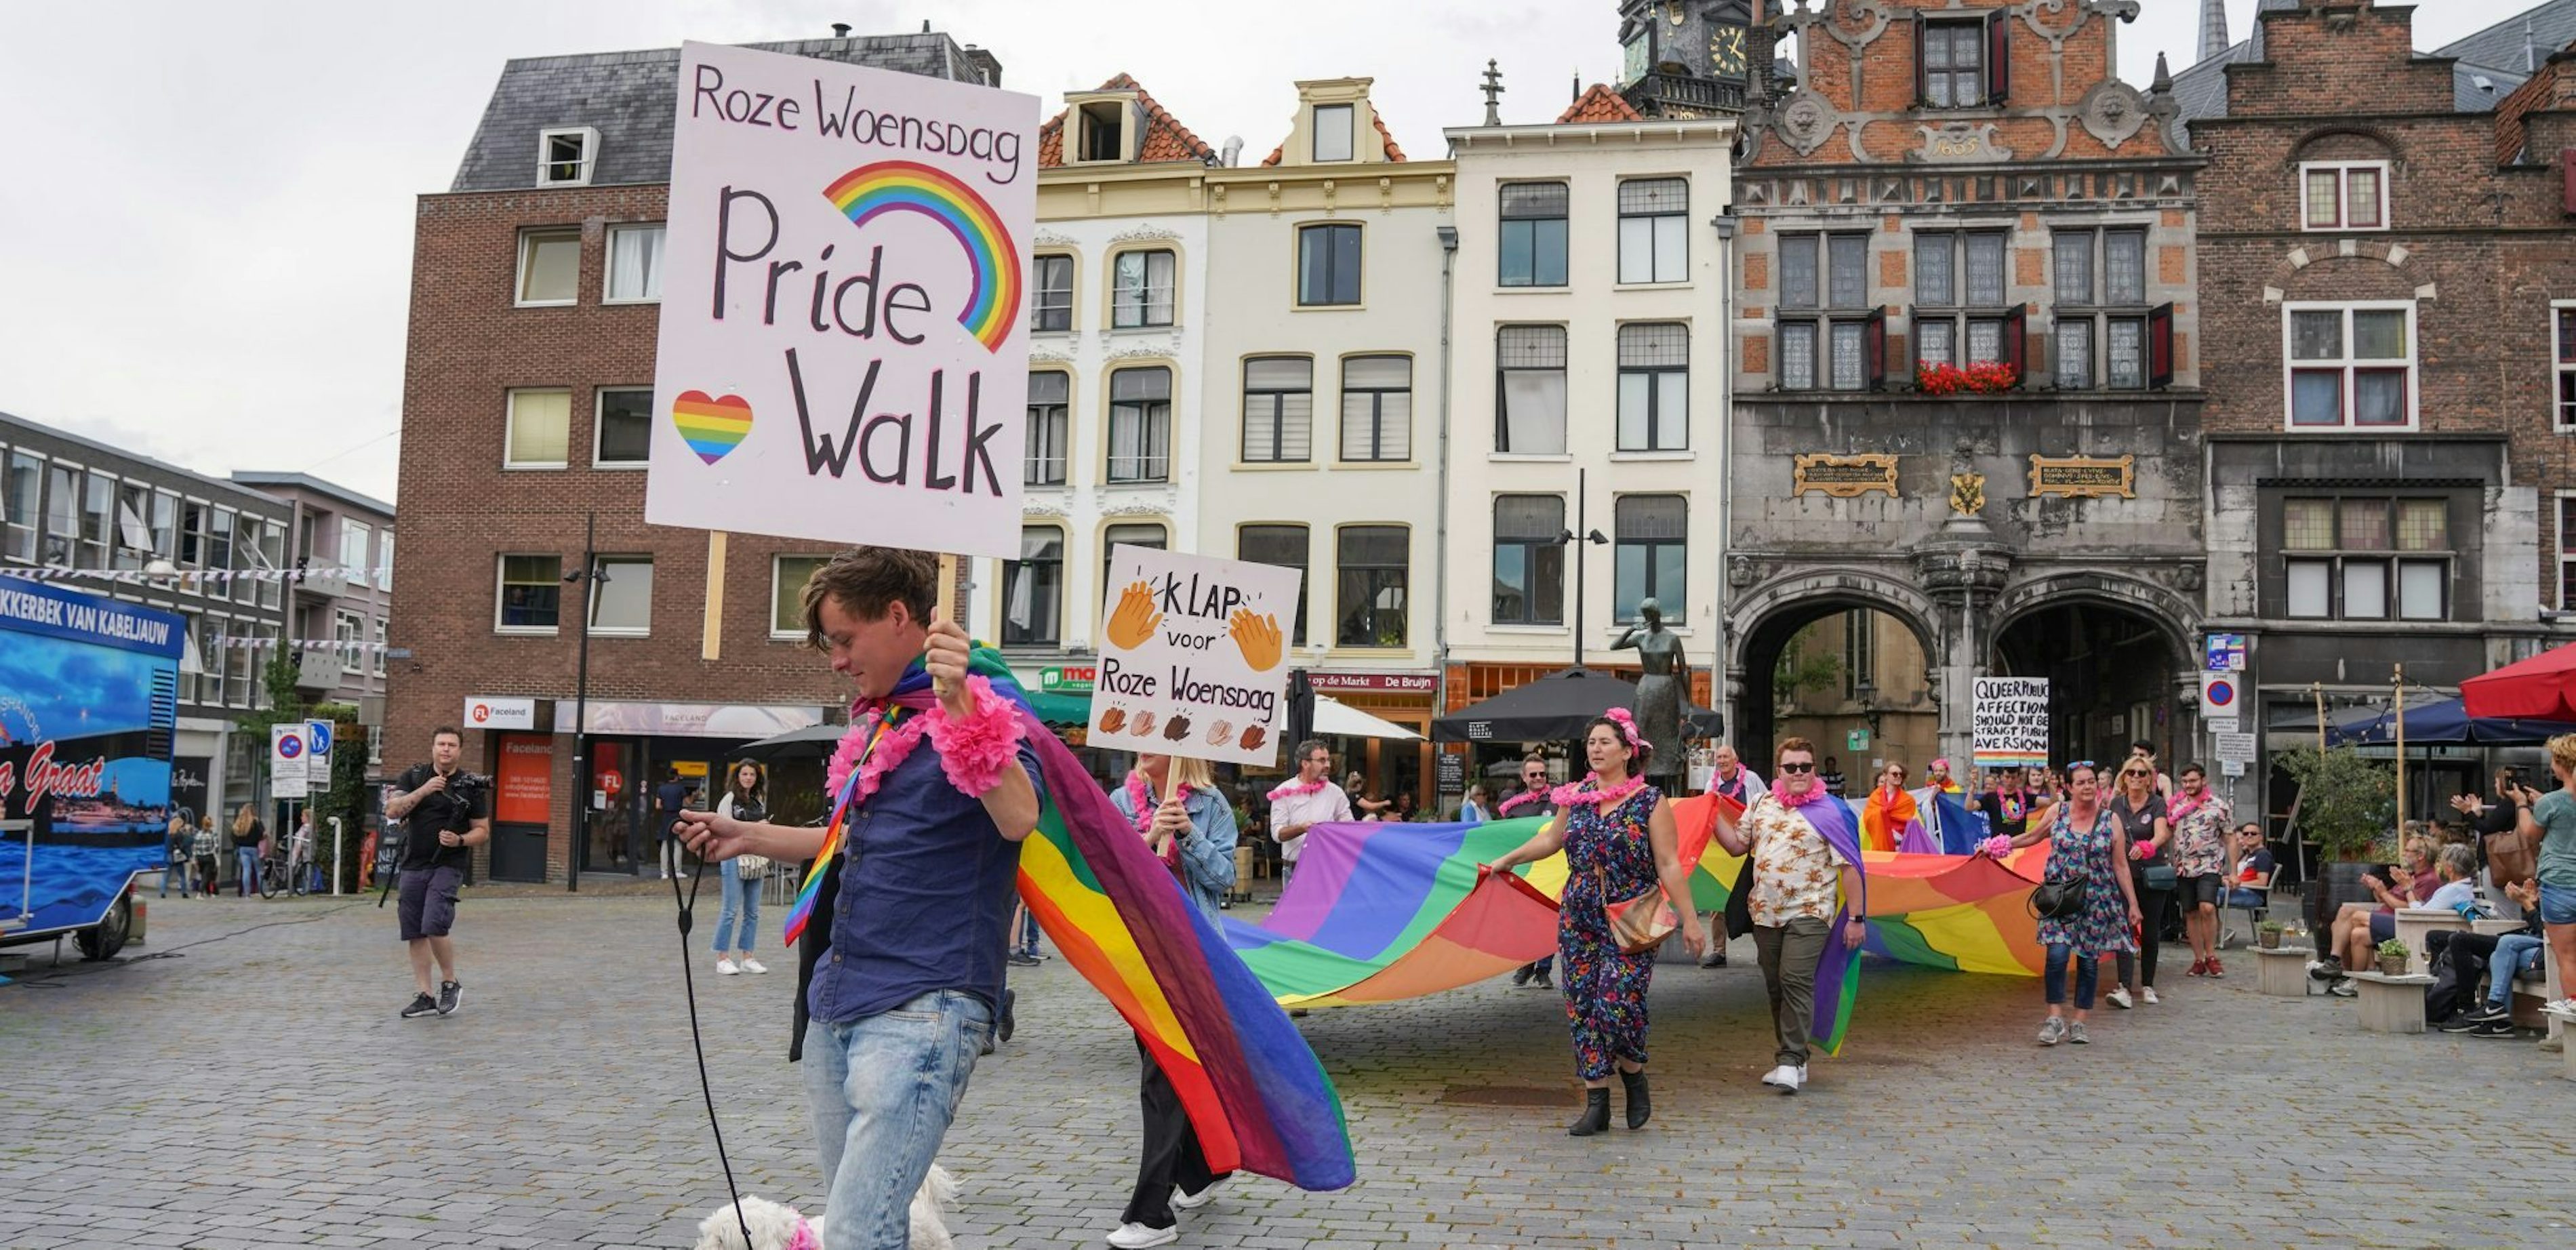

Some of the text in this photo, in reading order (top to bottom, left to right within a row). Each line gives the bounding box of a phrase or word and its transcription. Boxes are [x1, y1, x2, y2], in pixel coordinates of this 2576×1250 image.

[693, 64, 801, 130] Roze
[712, 186, 931, 345] Pride
[785, 348, 1003, 498] Walk
[1163, 571, 1241, 620] KLAP
[66, 603, 96, 633] VAN
[98, 610, 169, 646] KABELJAUW
[1167, 631, 1217, 651] voor
[1101, 658, 1156, 698] Roze
[1312, 676, 1370, 687] op de Markt
[1386, 677, 1431, 689] De Bruijn
[1975, 681, 2021, 699] QUEER
[490, 707, 526, 716] Faceland
[1976, 701, 2049, 714] AFFECTION
[1975, 714, 2048, 726] SHOULD NOT BE
[1975, 737, 2047, 751] AVERSION
[24, 740, 104, 815] Graat
[605, 775, 621, 788] FL
